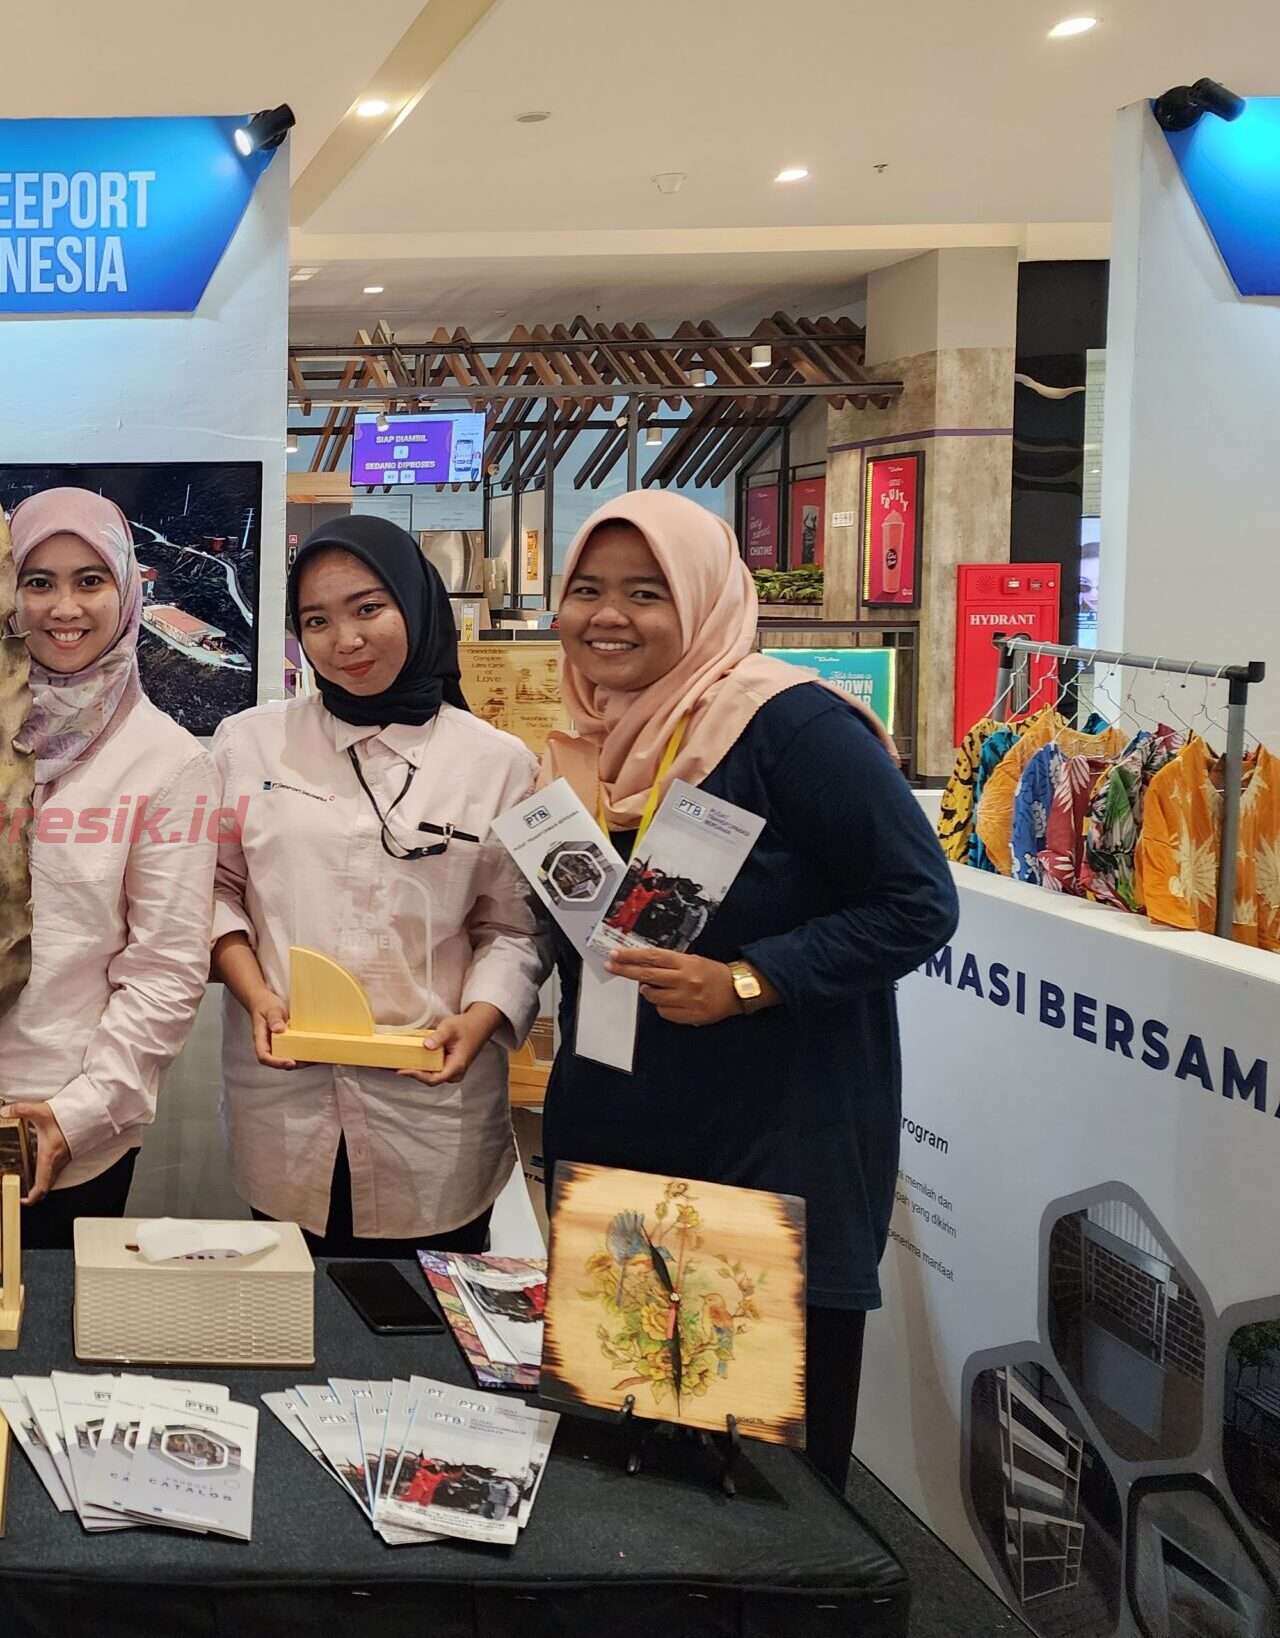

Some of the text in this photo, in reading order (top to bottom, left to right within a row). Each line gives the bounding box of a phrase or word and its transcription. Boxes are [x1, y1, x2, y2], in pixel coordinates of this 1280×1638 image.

[880, 488, 909, 512] FRUITY
[969, 614, 1036, 626] HYDRANT
[526, 809, 549, 826] PTB
[678, 799, 702, 817] PTB
[916, 945, 1280, 1119] MASI BERSAM
[901, 1116, 949, 1154] rogram
